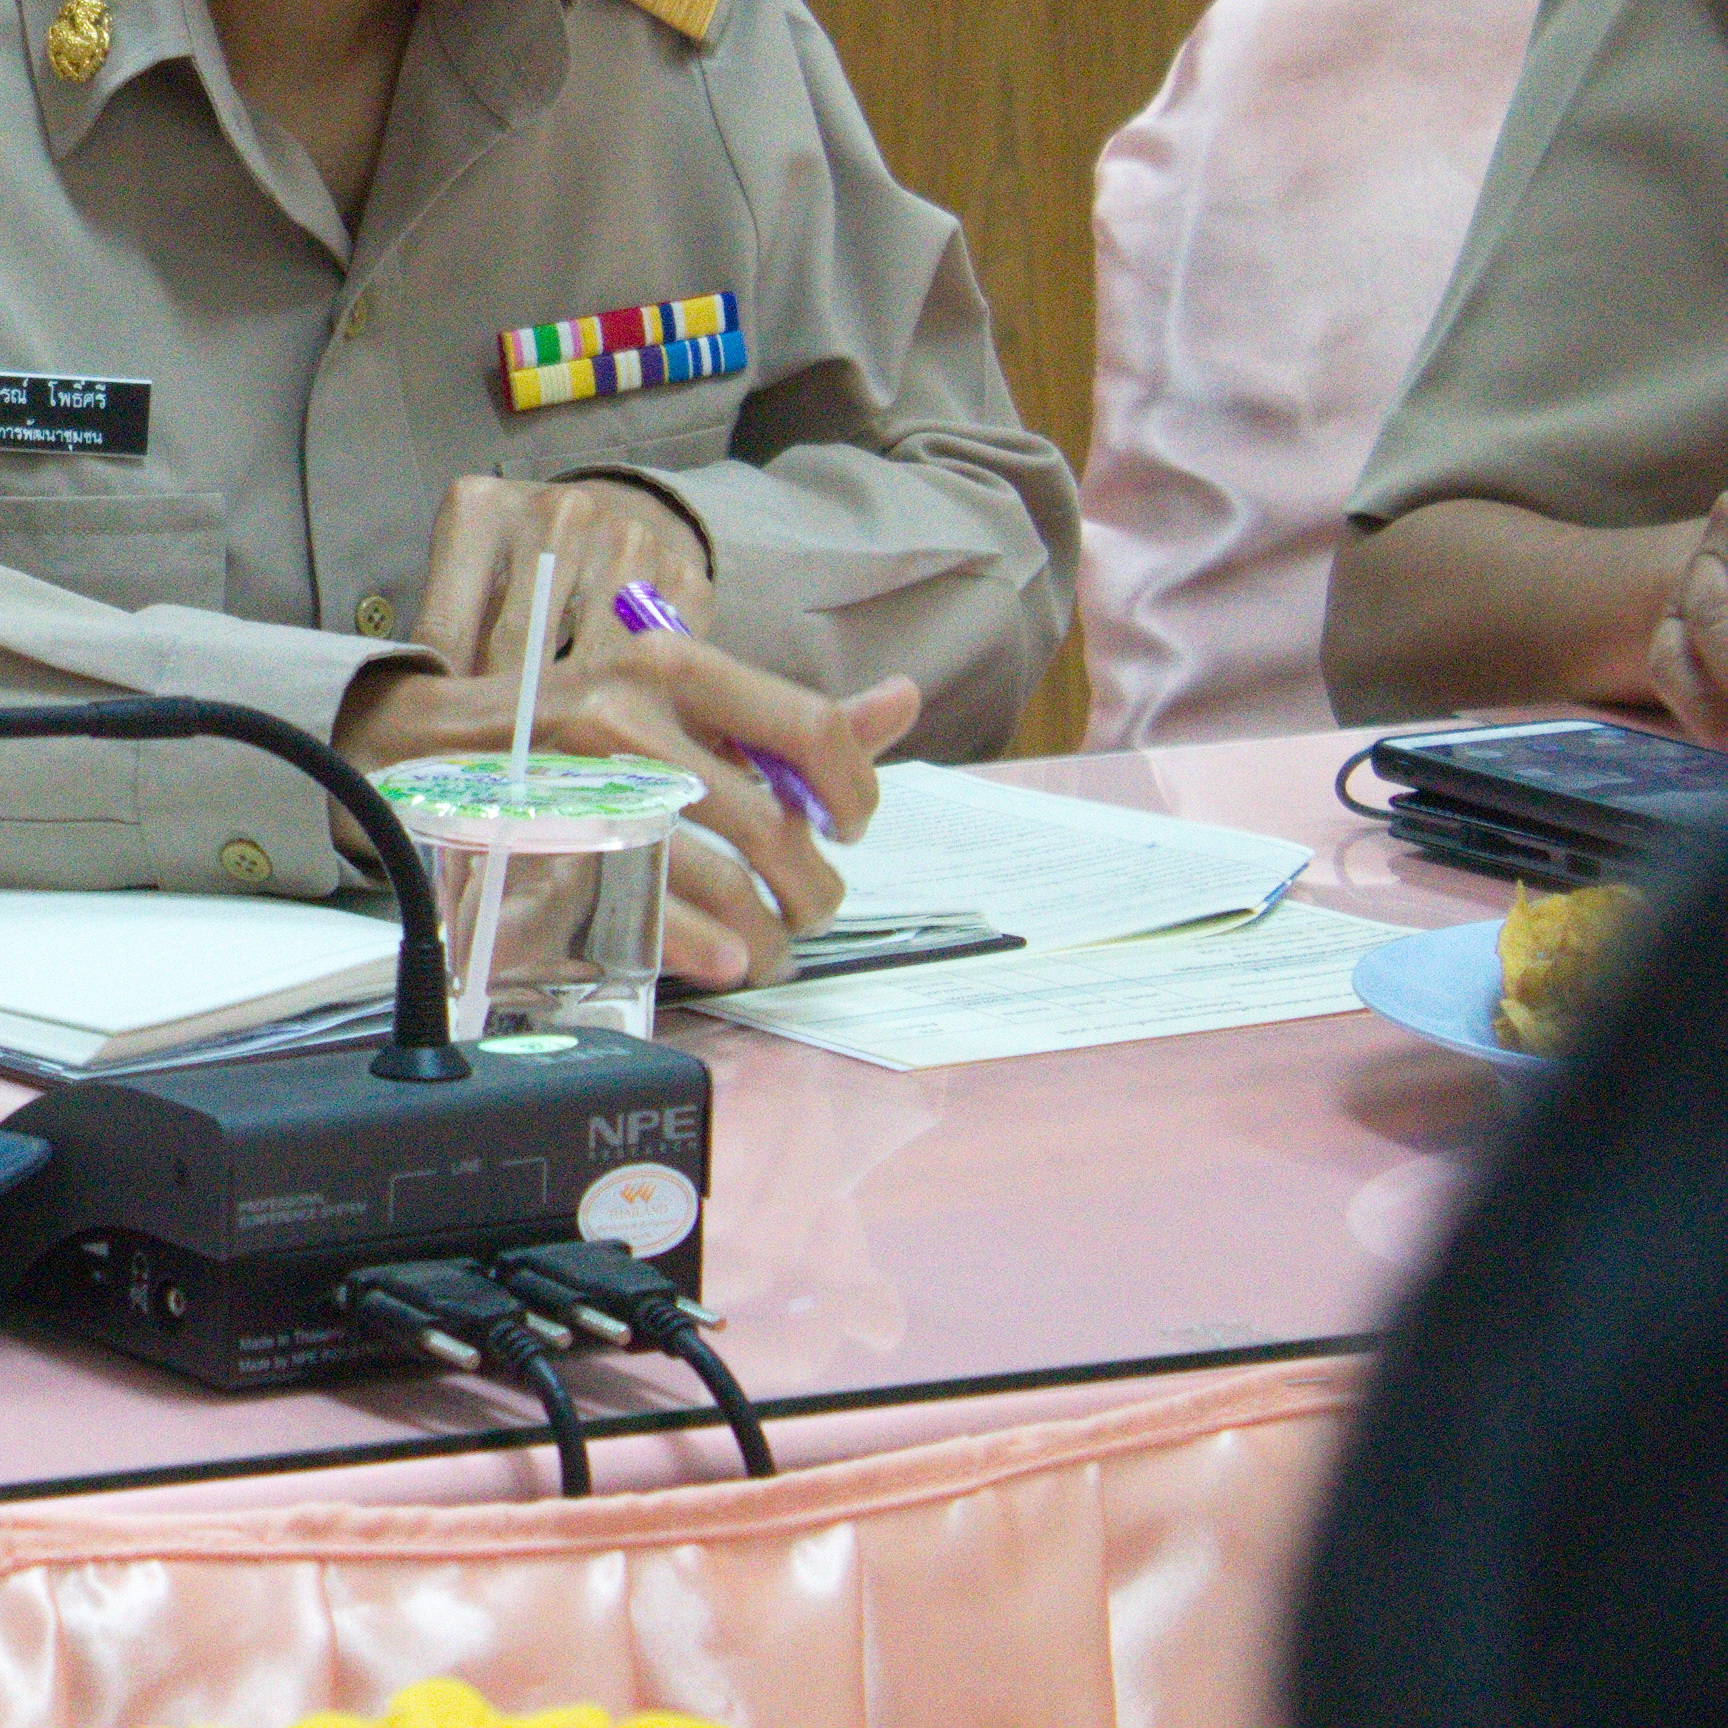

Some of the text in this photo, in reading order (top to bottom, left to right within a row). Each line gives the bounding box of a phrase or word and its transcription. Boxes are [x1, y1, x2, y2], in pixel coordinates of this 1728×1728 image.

[47, 380, 107, 410] โพธิ์ศรี
[587, 1104, 698, 1149] NPE
